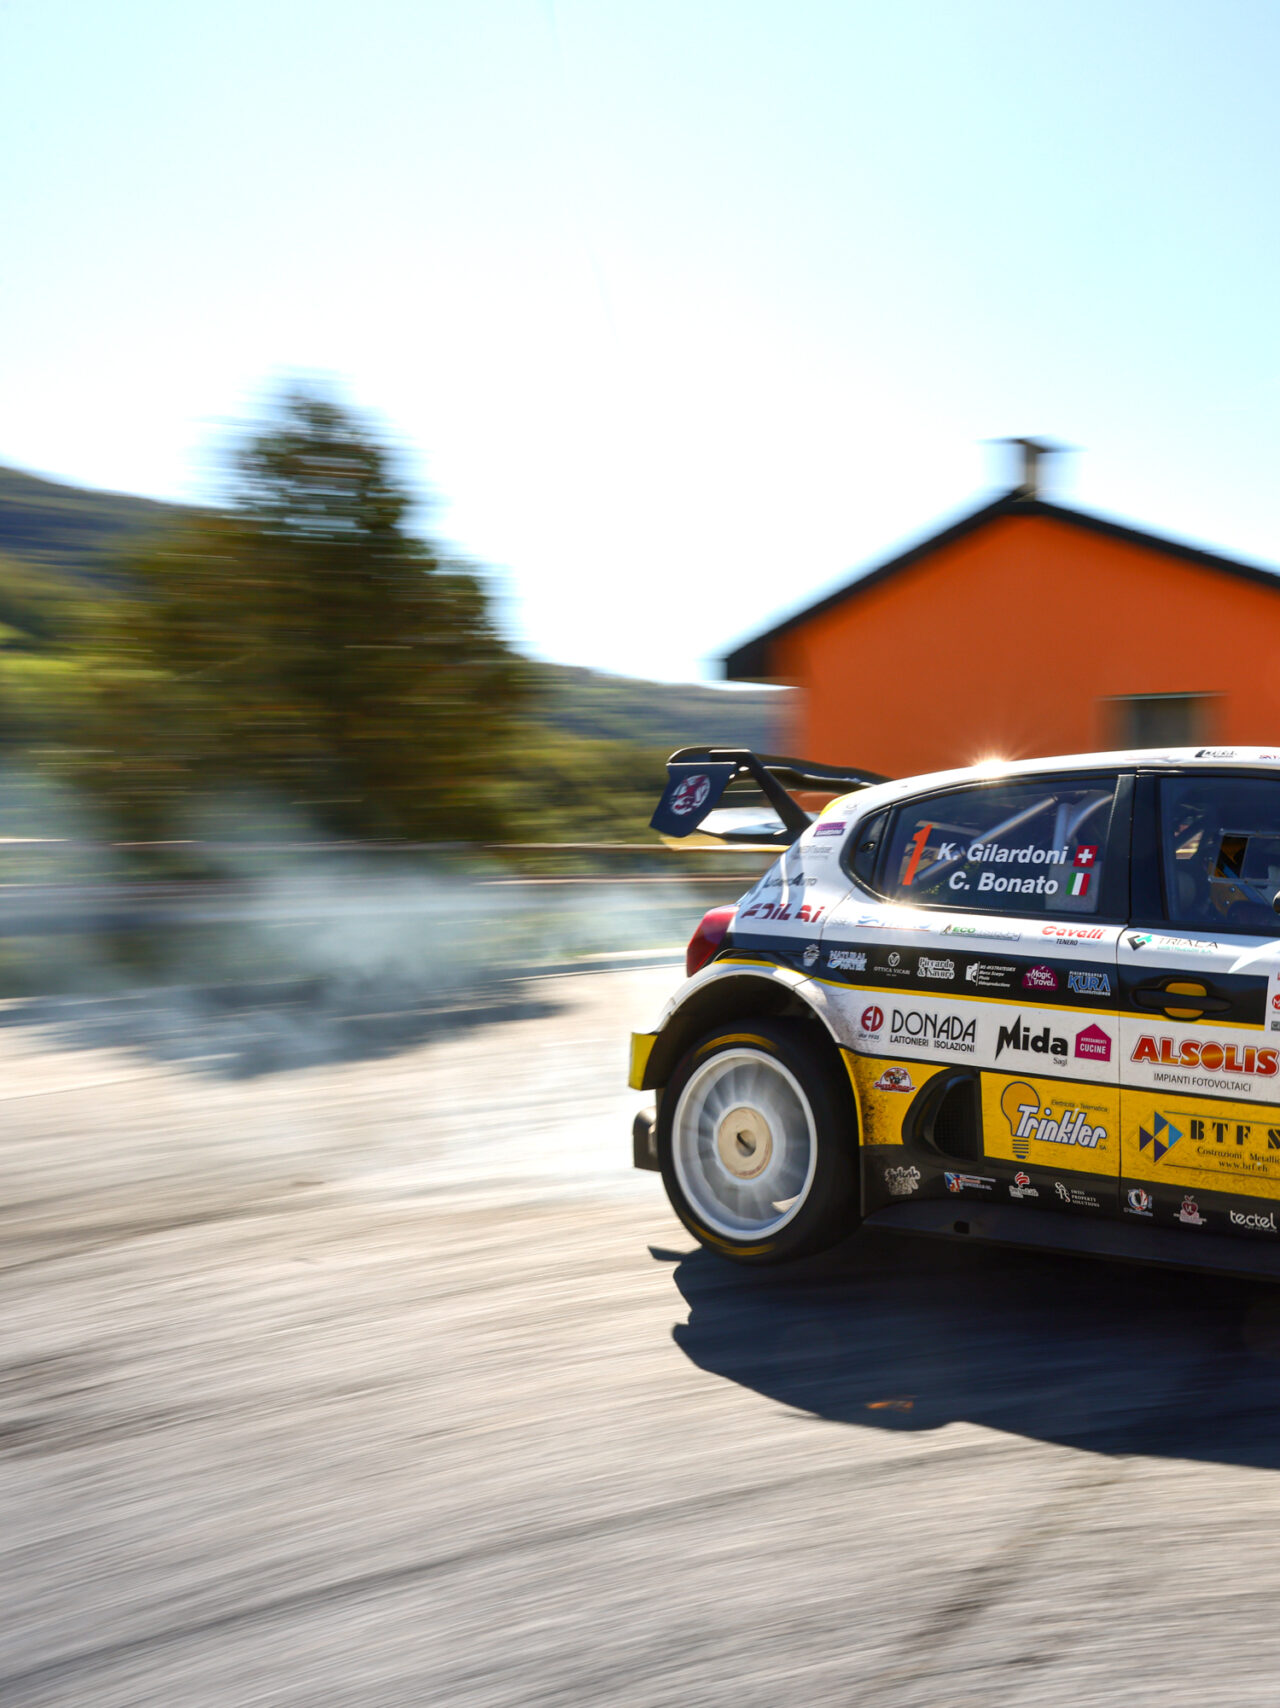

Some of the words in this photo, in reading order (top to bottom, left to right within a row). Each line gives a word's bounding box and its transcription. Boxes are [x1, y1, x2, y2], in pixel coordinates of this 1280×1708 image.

[902, 824, 933, 886] 1
[937, 842, 958, 861] K.
[966, 843, 1069, 865] Gilardoni
[949, 871, 971, 891] C.
[977, 872, 1059, 895] Bonato
[1041, 925, 1107, 940] Cavalli
[1031, 968, 1052, 979] Magic
[1033, 977, 1054, 987] Travel
[1067, 973, 1111, 992] KURA
[891, 1009, 977, 1043] DONADA
[890, 1035, 929, 1047] LATTONIERI
[934, 1041, 975, 1053] ISOLAZIONI
[995, 1014, 1068, 1061] Mida
[1080, 1043, 1106, 1055] CUCINE
[1130, 1035, 1280, 1078] ALSOLIS
[1153, 1072, 1191, 1085] IMPIANTI
[1192, 1077, 1251, 1092] FOTOVOLTAICI
[1016, 1103, 1108, 1149] Trinkler
[1197, 1146, 1243, 1160] Costruzioni
[1071, 1194, 1097, 1202] PROPERTY
[1229, 1209, 1277, 1230] tectel
